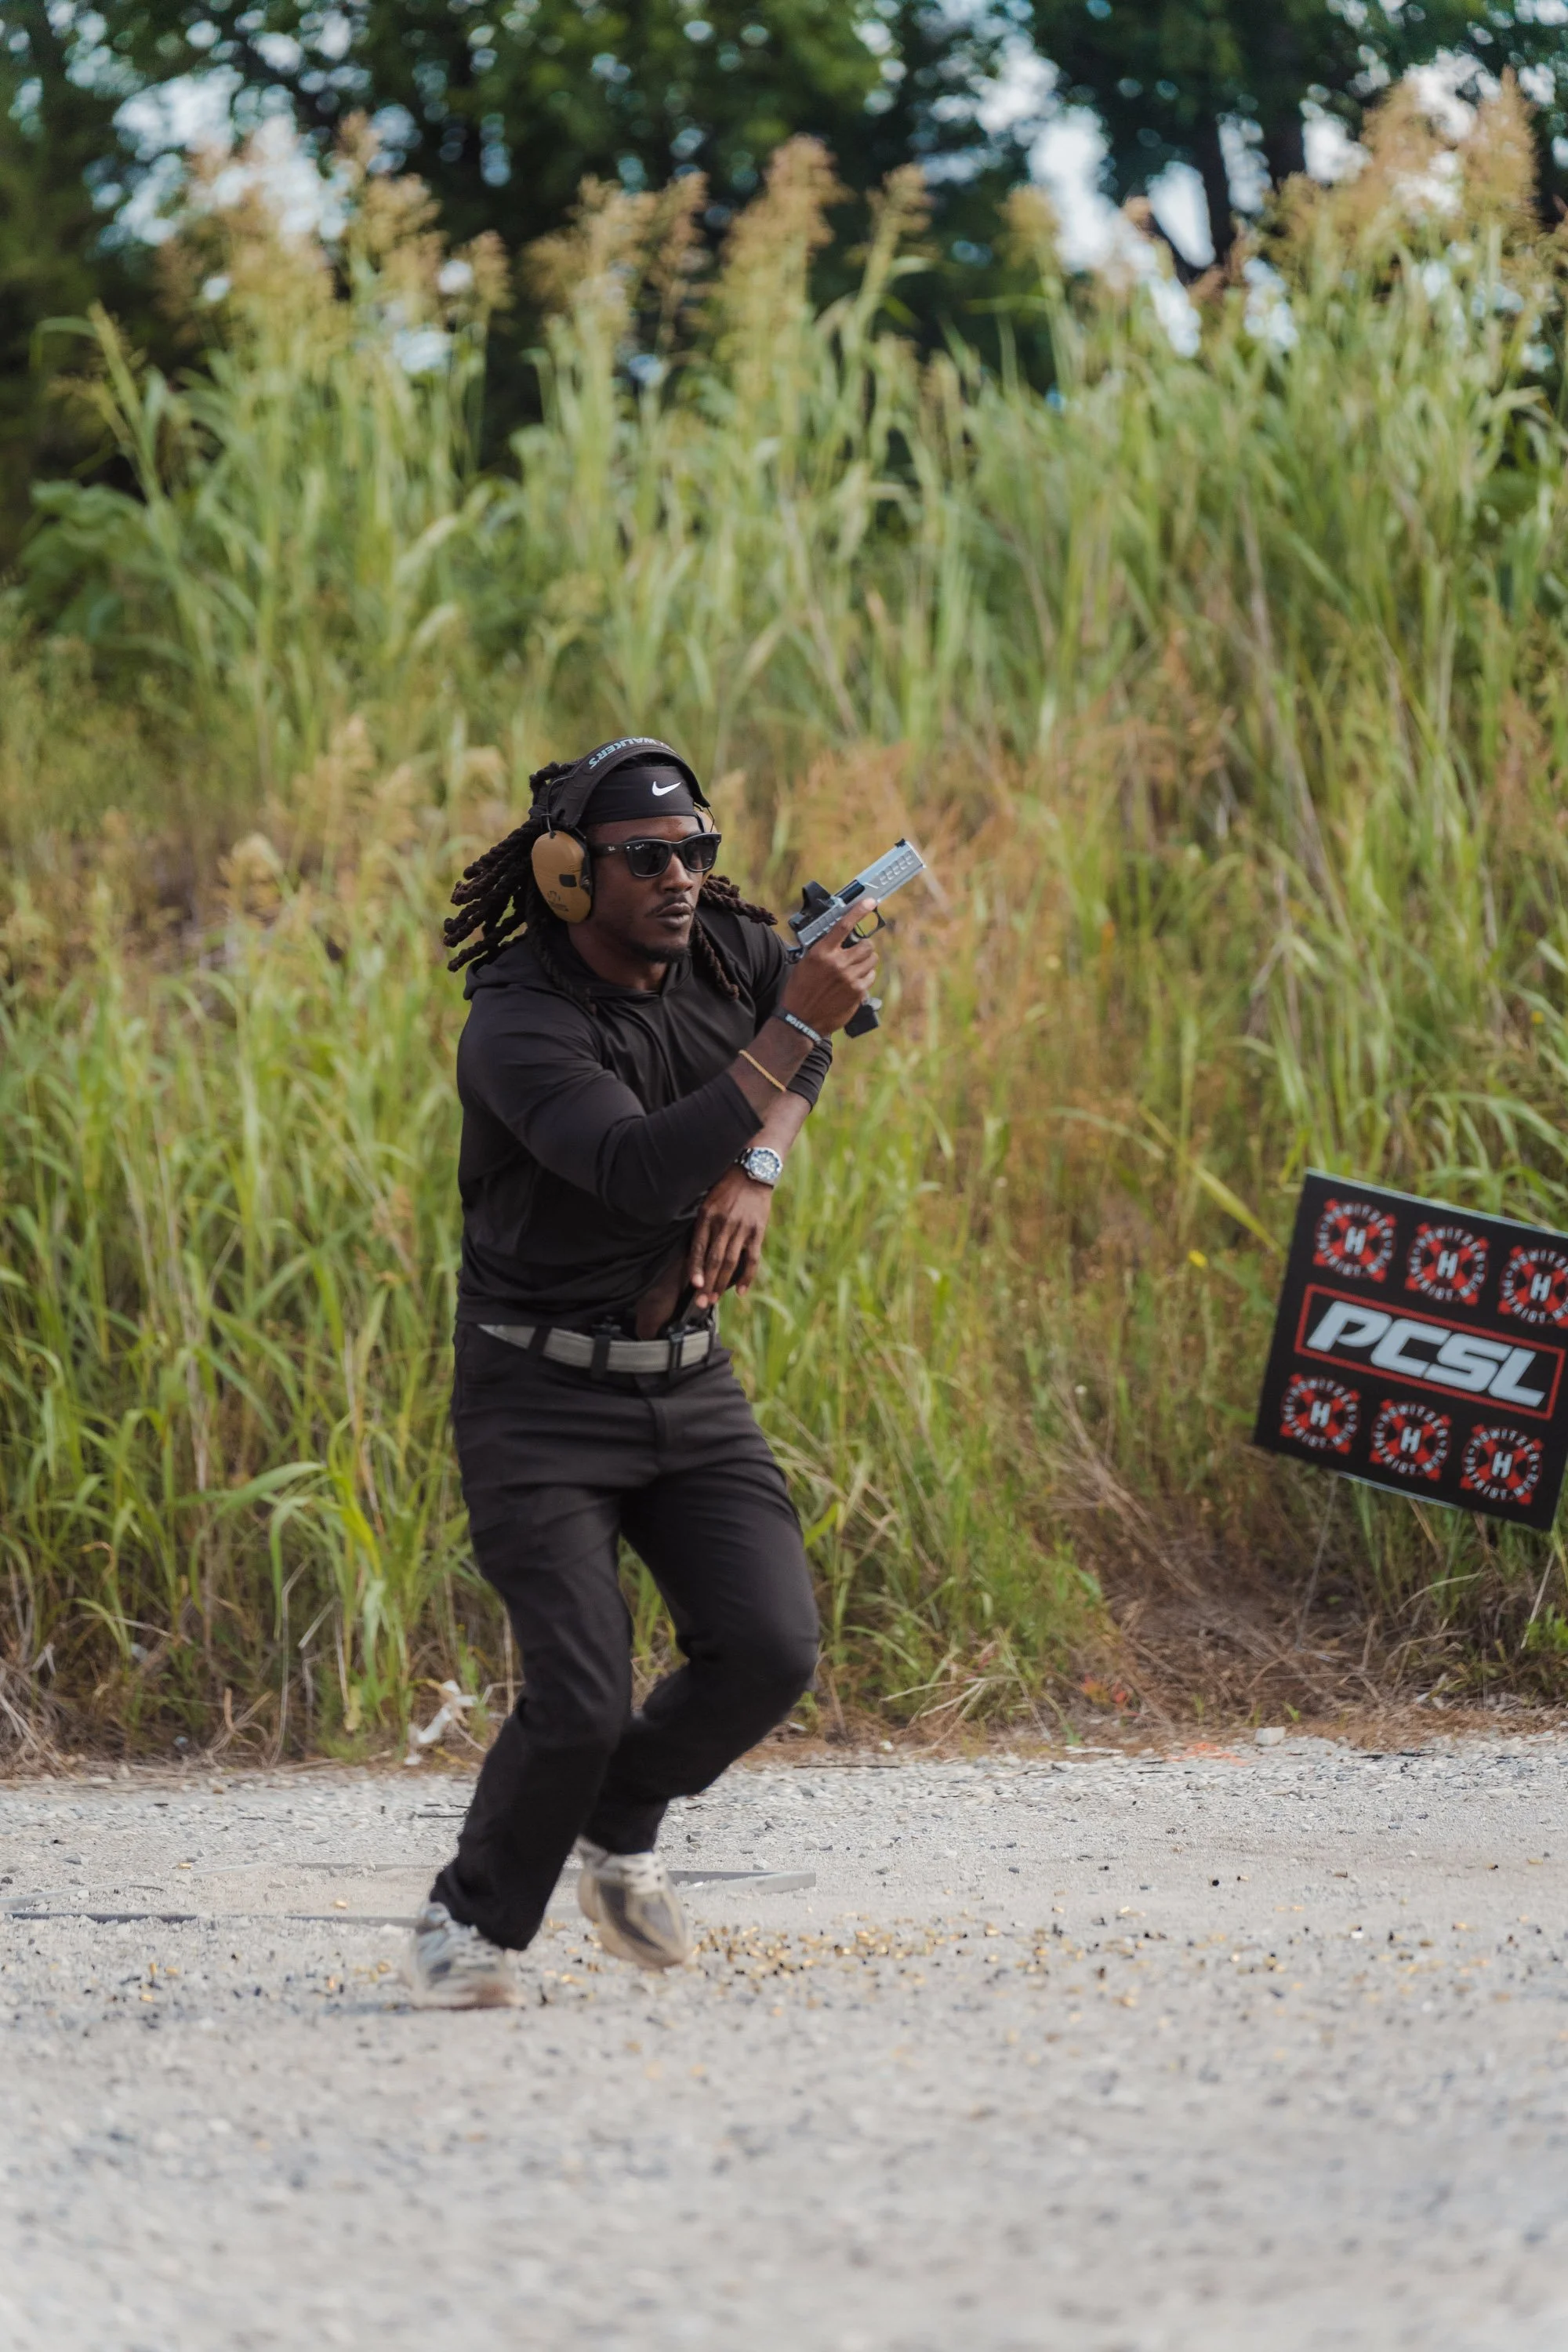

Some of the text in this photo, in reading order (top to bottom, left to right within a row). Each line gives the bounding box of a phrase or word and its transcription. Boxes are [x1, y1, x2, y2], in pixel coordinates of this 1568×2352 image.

[589, 737, 657, 770] WALKER'S
[1345, 1227, 1367, 1254] H
[1437, 1251, 1459, 1279] H
[1530, 1274, 1552, 1301] H
[1307, 1301, 1546, 1407] PCSL
[1309, 1400, 1331, 1428] H
[1400, 1426, 1422, 1454] H
[1491, 1451, 1513, 1479] H
